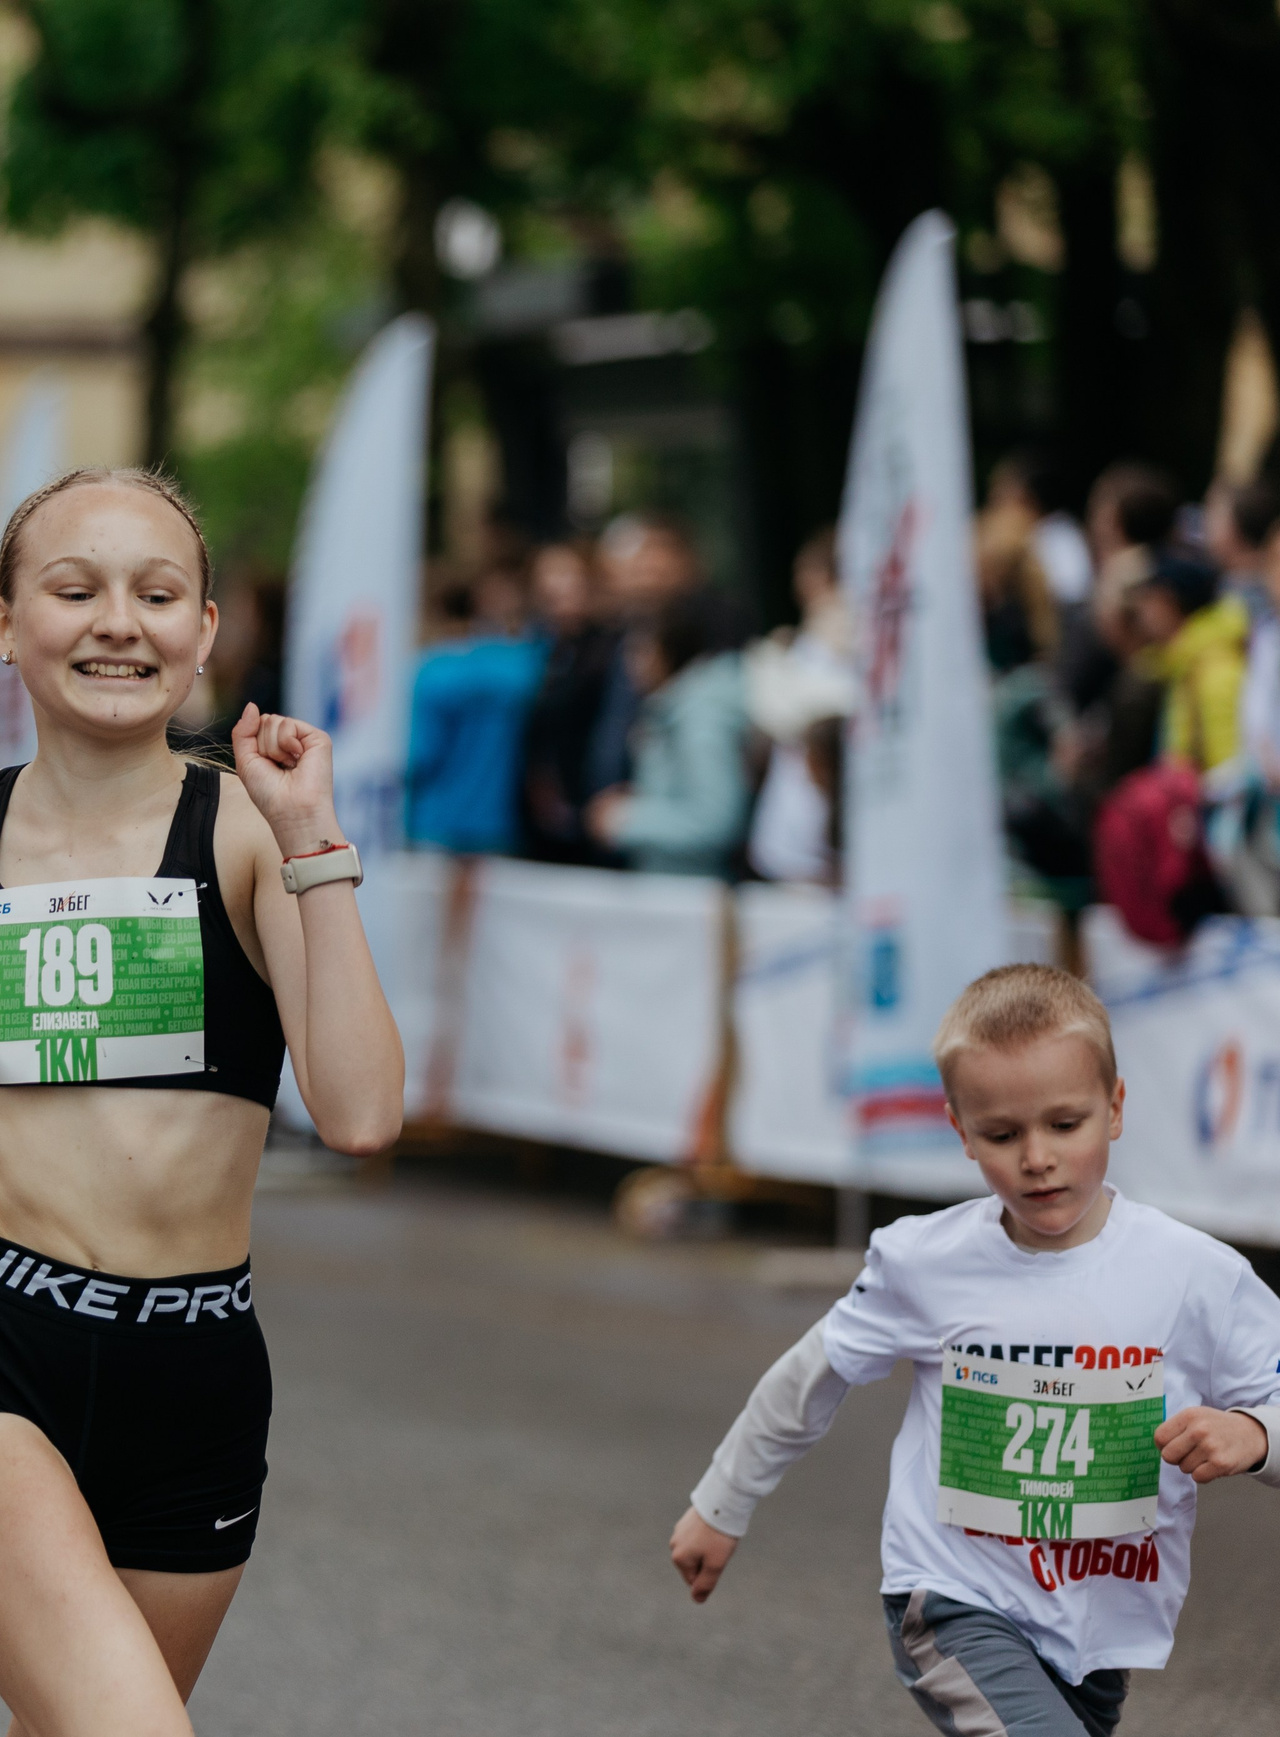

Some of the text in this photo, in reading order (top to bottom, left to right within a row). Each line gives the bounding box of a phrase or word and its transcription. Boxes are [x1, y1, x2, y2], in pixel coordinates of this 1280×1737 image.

[19, 923, 114, 1007] 189
[32, 1010, 99, 1030] ЕЛИЗАВЕТА
[972, 1370, 998, 1385] ПСБ
[1002, 1401, 1095, 1477] 274
[1019, 1479, 1075, 1499] ТИМОФЕЙ
